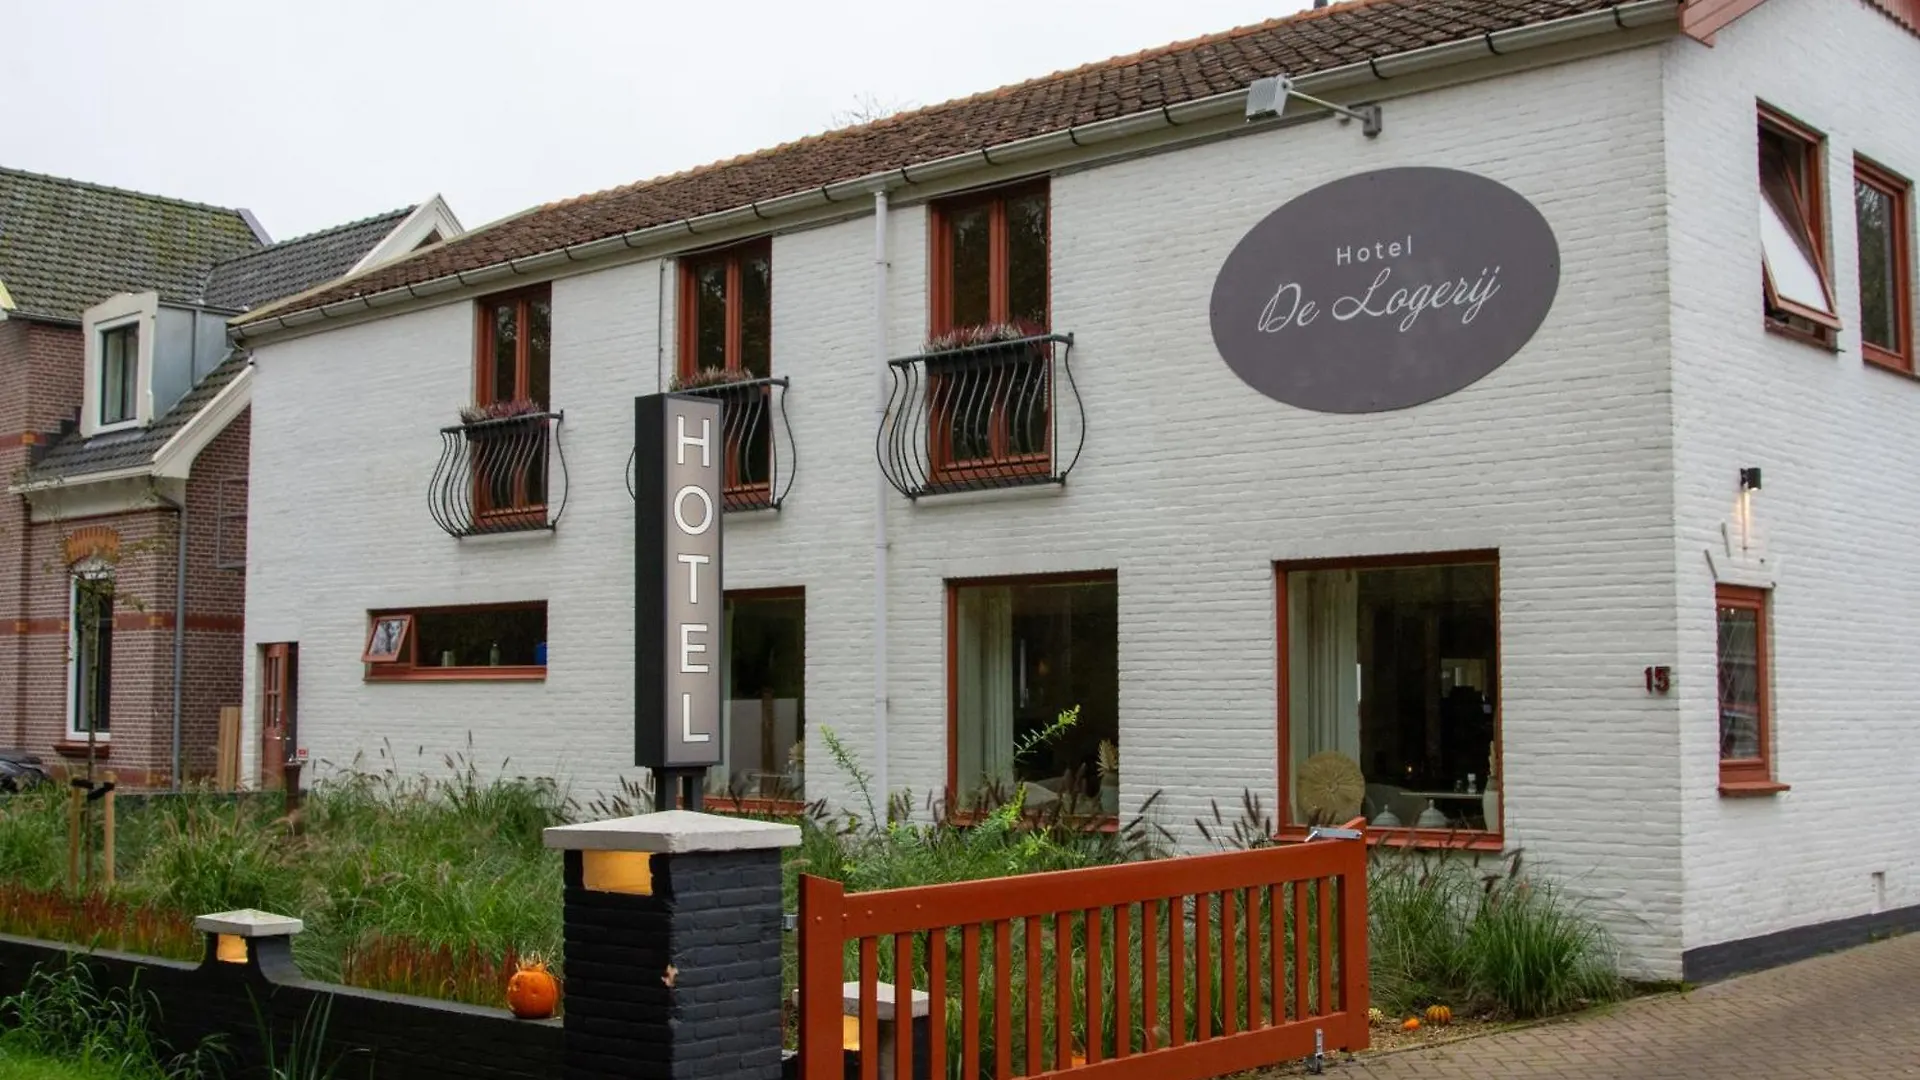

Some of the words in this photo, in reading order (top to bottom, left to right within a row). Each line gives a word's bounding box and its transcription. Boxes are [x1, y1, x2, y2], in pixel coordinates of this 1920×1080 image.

[1336, 235, 1413, 267] Hotel
[1257, 282, 1321, 333] De
[1331, 265, 1502, 332] Logerij
[673, 414, 714, 744] HOTEL
[1644, 665, 1671, 696] 15
